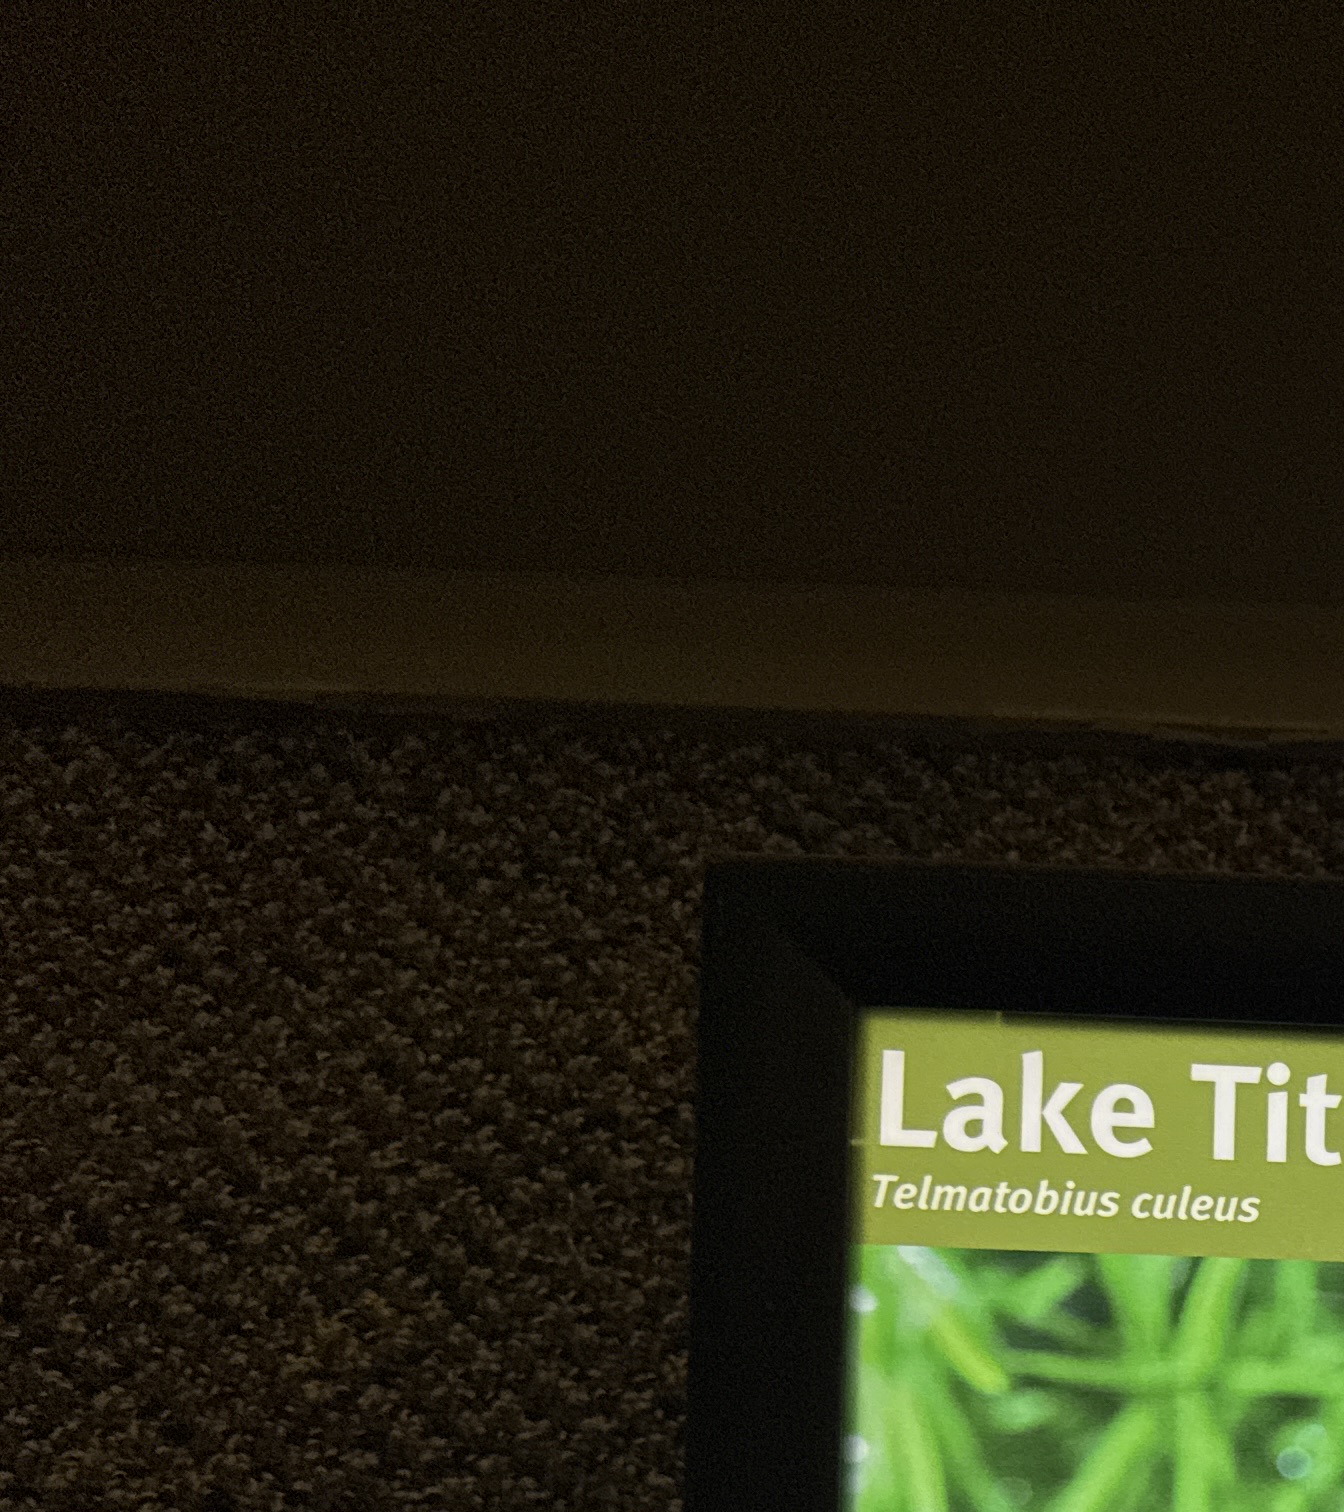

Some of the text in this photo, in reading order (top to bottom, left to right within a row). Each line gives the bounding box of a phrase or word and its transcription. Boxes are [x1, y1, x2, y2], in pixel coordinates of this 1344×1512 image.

[879, 1049, 1155, 1158] Lake
[872, 1173, 1261, 1223] Telmatobius culeus
